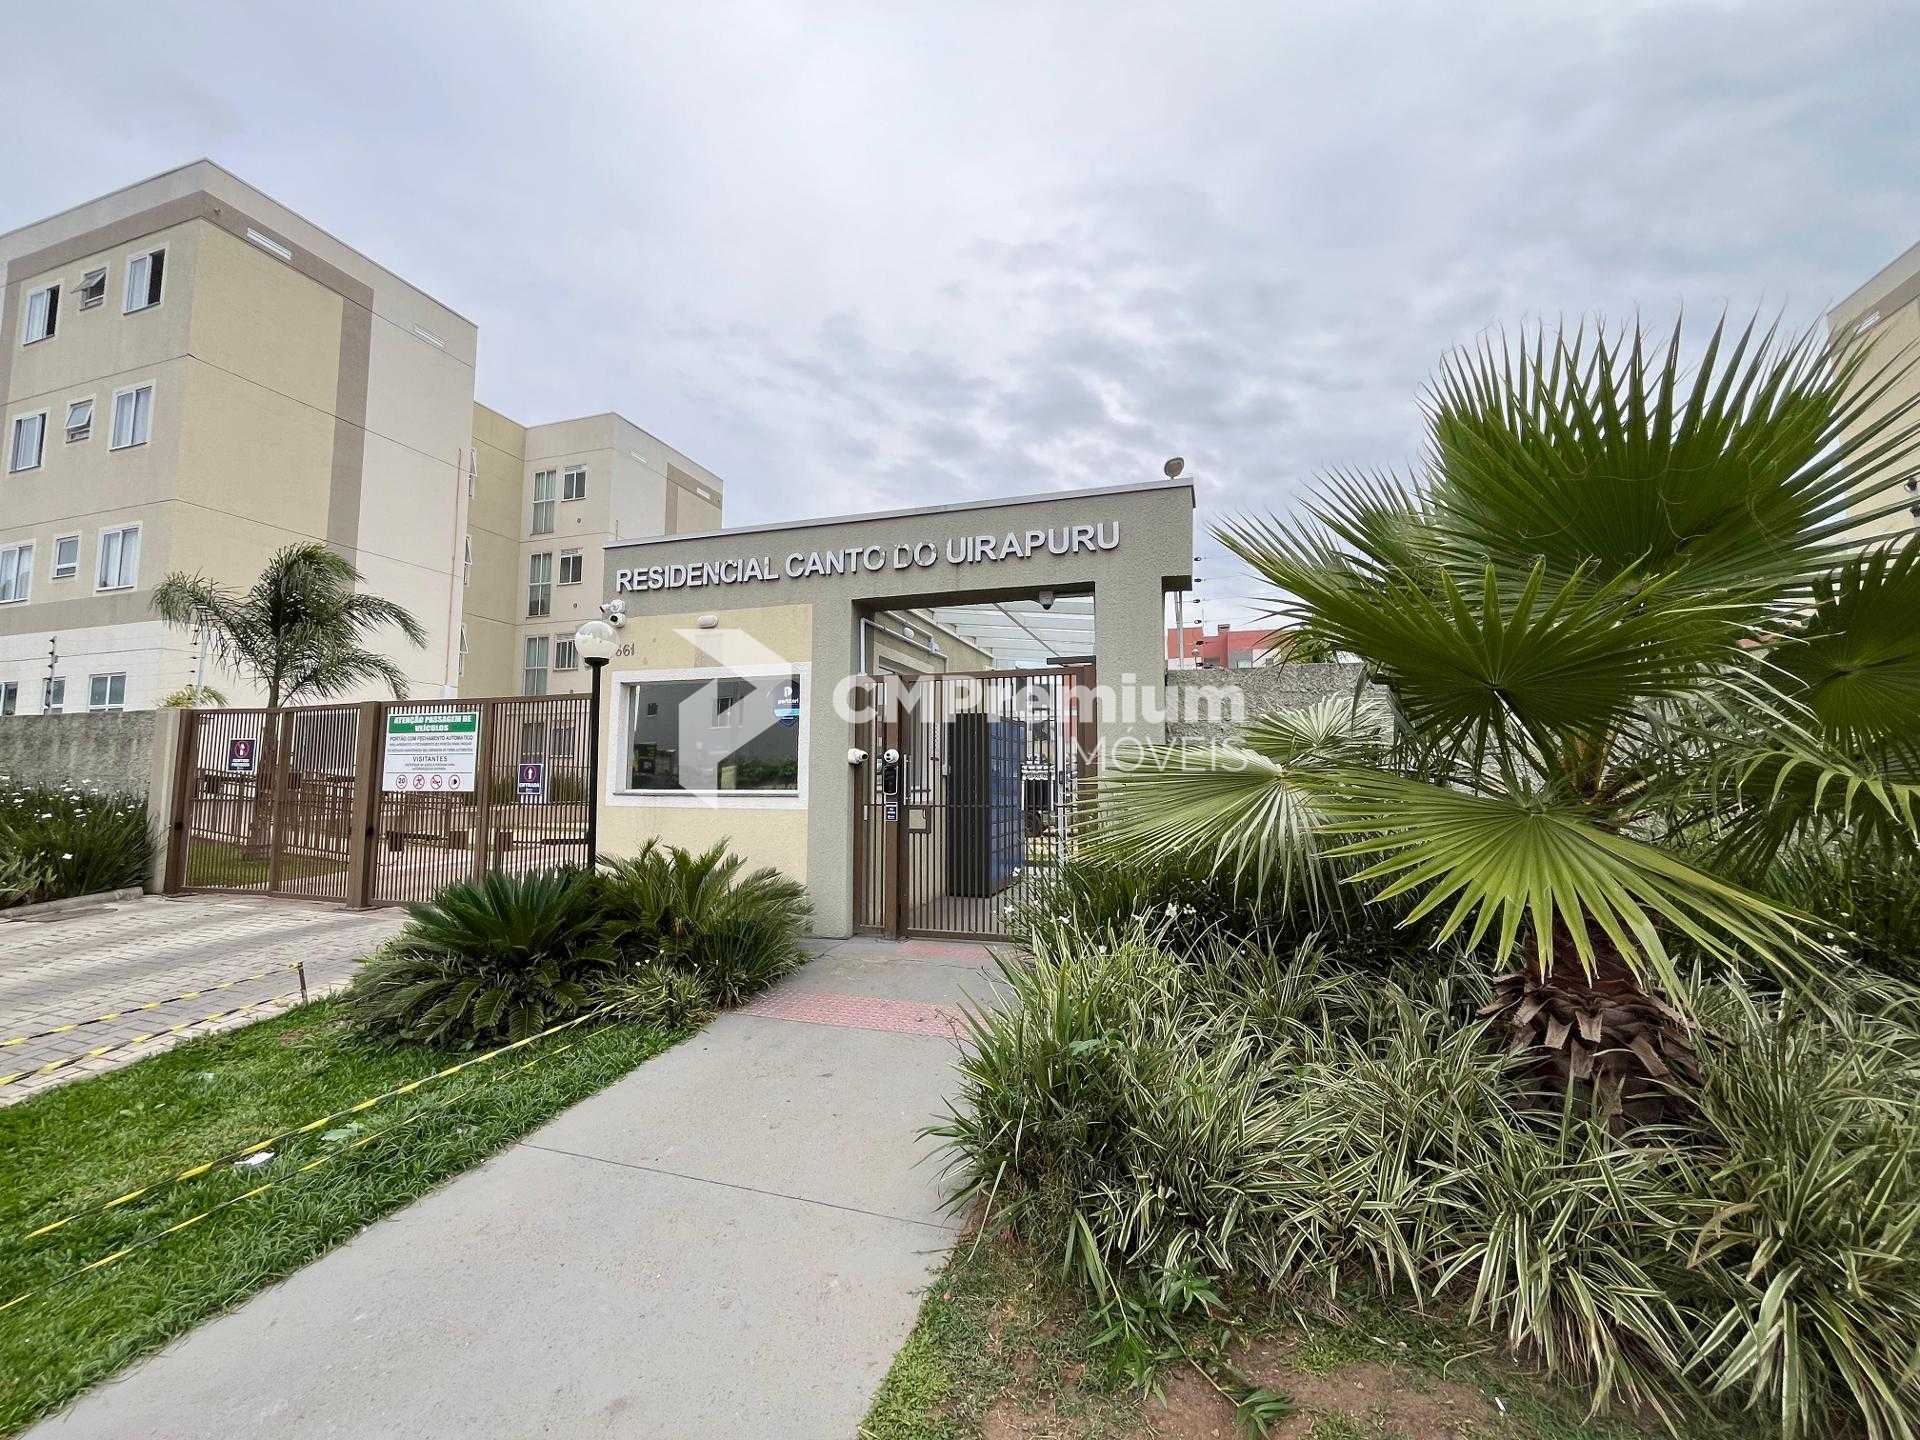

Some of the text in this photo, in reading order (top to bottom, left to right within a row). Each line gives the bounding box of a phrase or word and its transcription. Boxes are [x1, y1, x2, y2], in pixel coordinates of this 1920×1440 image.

[615, 520, 1120, 593] RESIDENCIAL CANTO DO UIRAPURU
